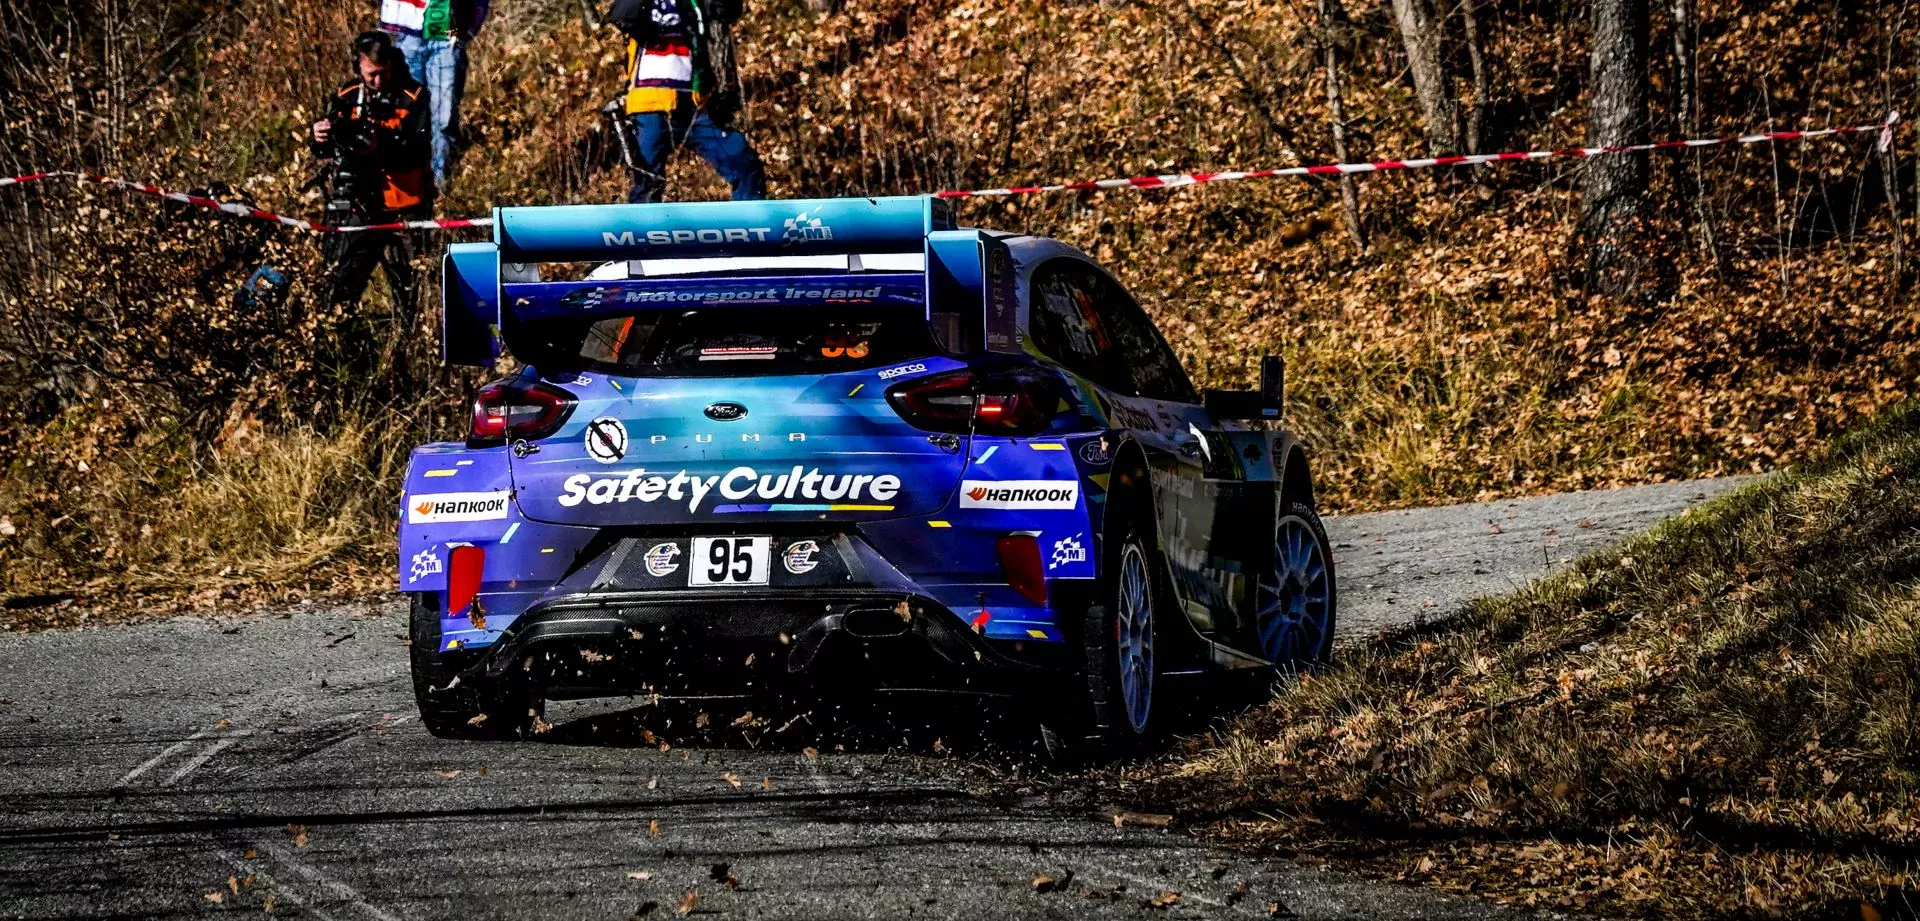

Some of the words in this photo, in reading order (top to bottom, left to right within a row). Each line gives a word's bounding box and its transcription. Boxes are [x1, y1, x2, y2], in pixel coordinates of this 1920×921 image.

[602, 228, 771, 247] M-SPORT
[625, 288, 777, 304] Motorsport
[785, 286, 881, 301] Ireland
[878, 363, 926, 379] sparco
[650, 432, 807, 443] PUMA
[558, 465, 900, 514] SafetyCulture
[707, 539, 754, 582] 95
